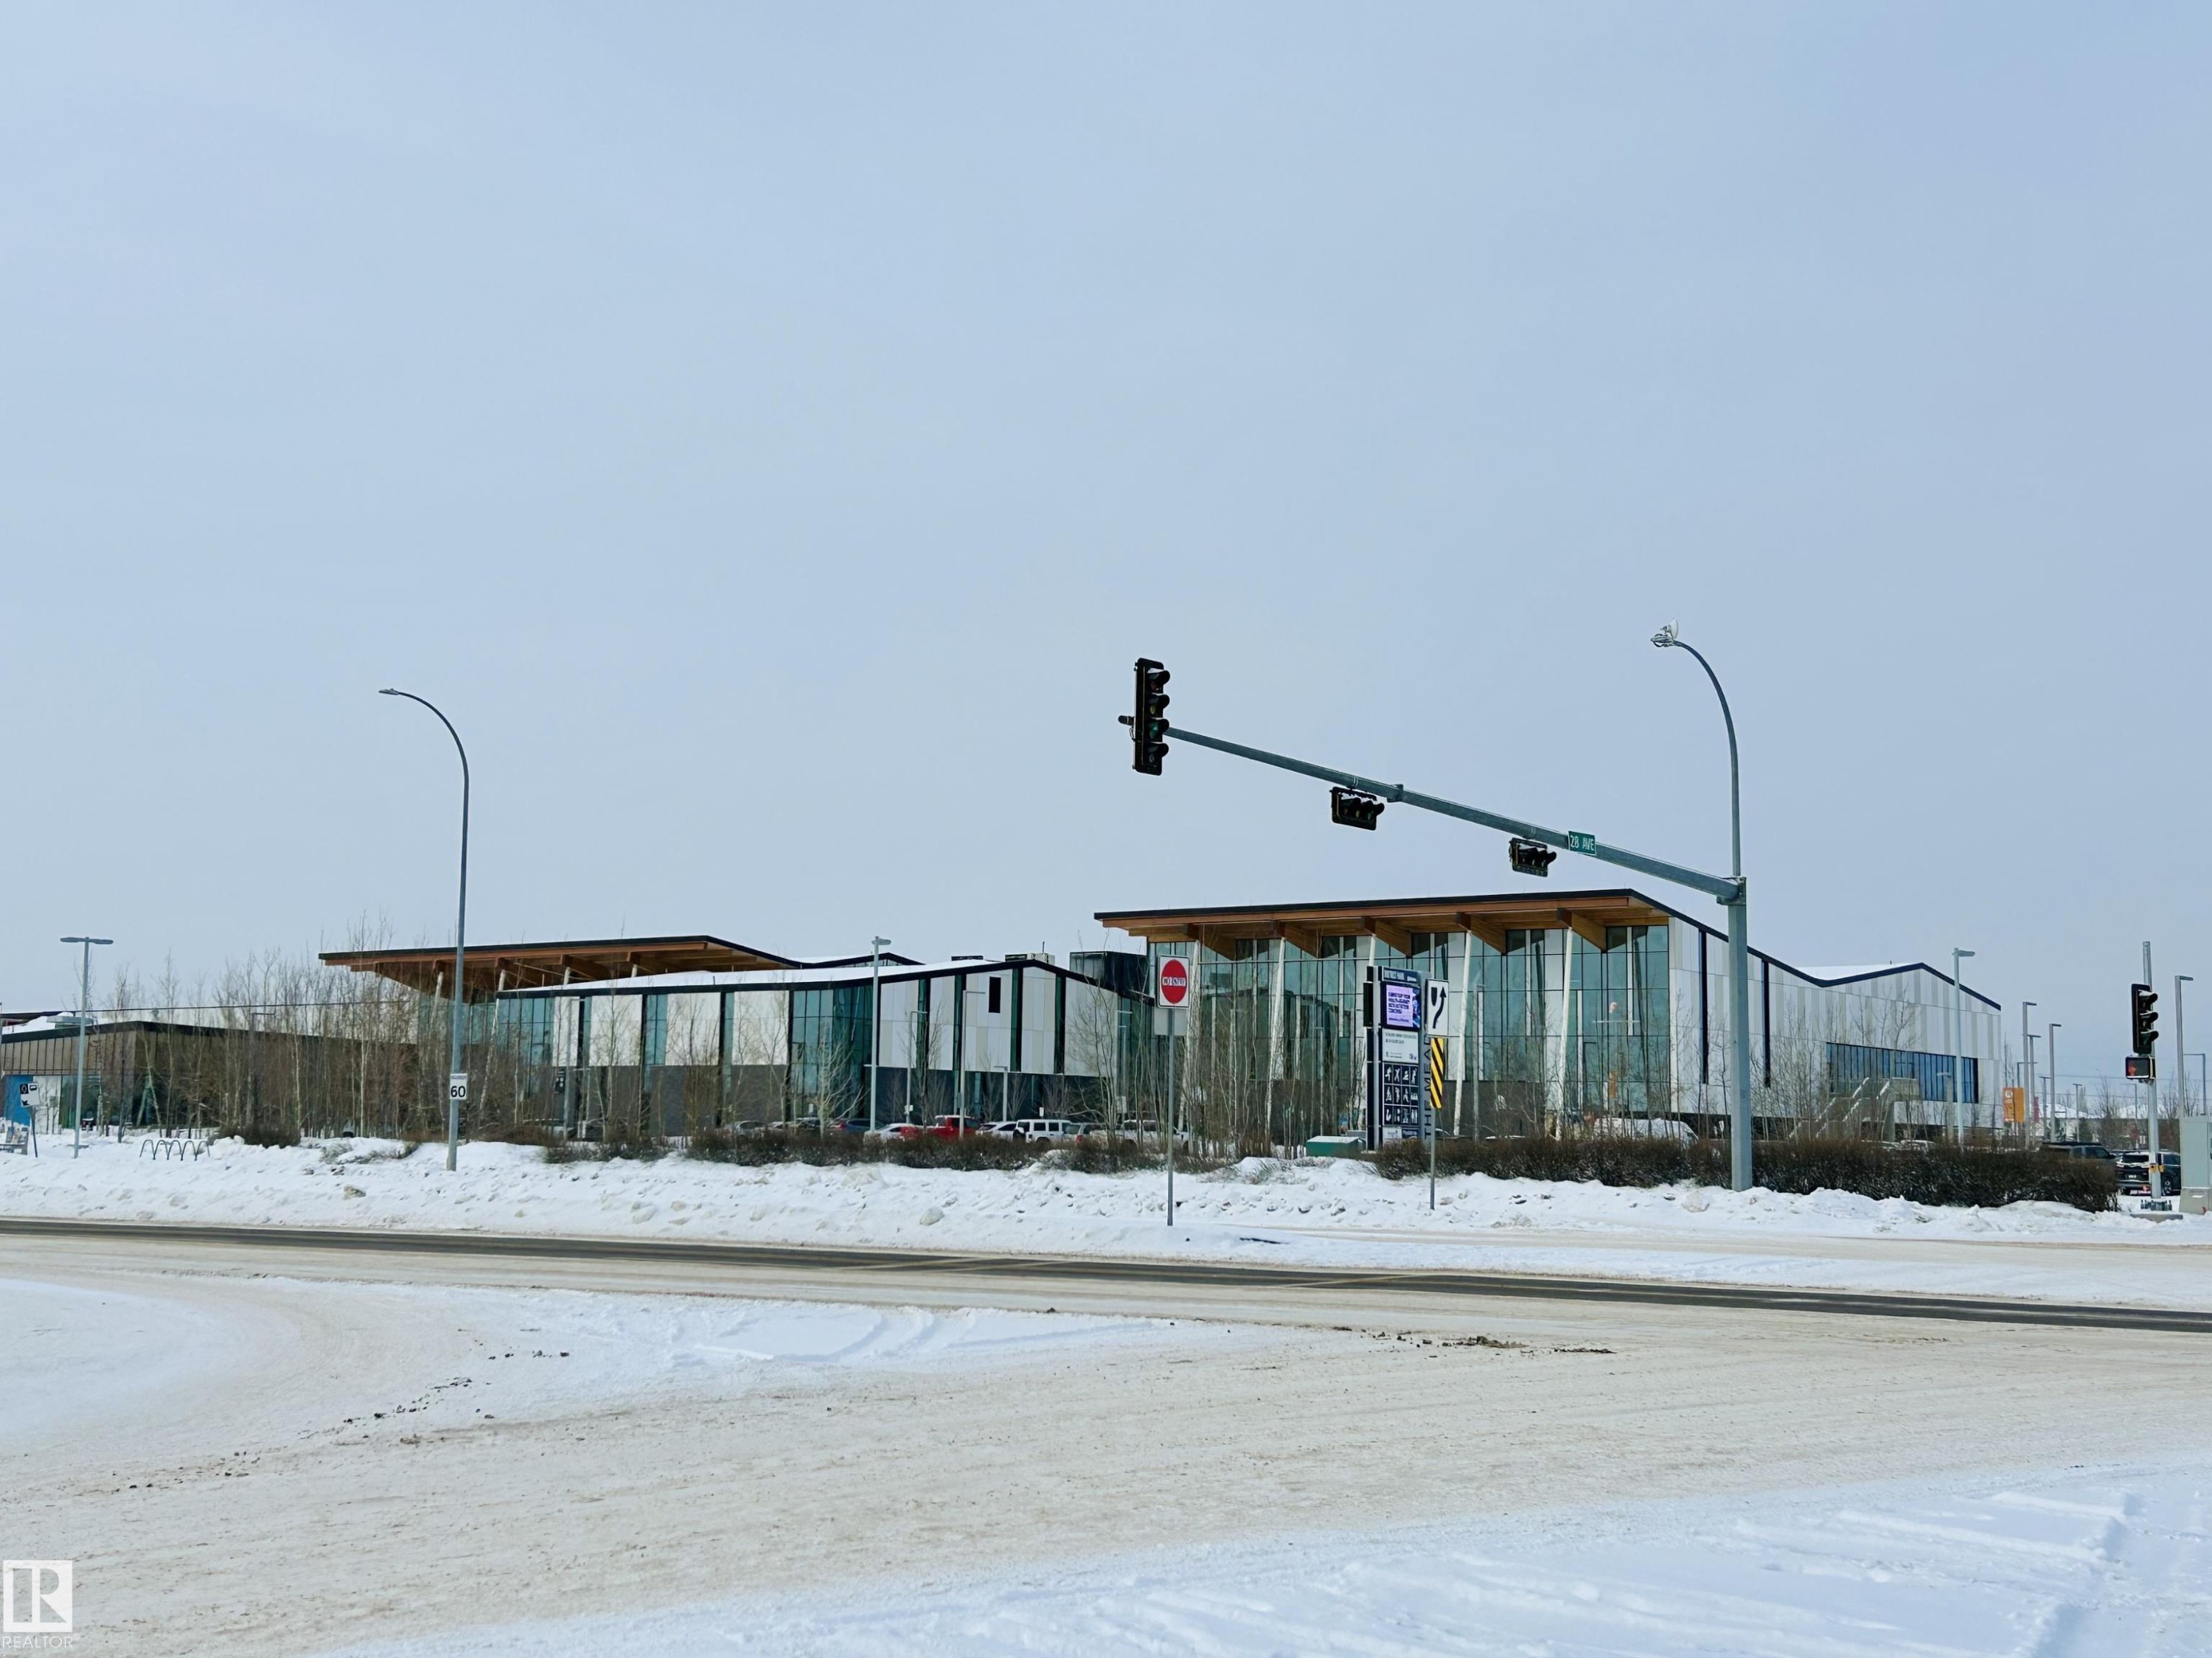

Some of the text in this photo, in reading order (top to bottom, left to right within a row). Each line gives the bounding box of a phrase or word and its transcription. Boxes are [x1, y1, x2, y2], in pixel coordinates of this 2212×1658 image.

[1571, 835, 1595, 851] 28 AVE
[451, 1085, 466, 1098] 60
